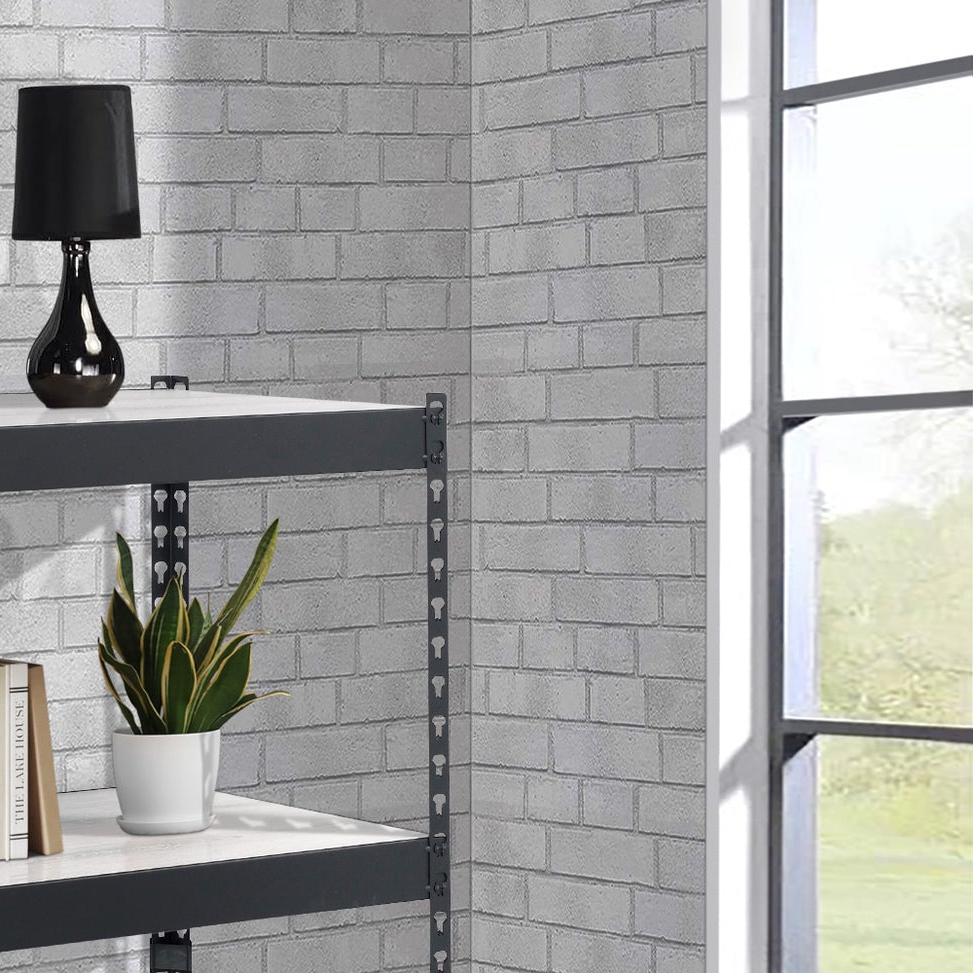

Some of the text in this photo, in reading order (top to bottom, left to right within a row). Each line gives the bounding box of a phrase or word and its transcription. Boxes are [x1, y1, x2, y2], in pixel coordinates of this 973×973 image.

[14, 700, 25, 825] THE LAKE HOUSE
